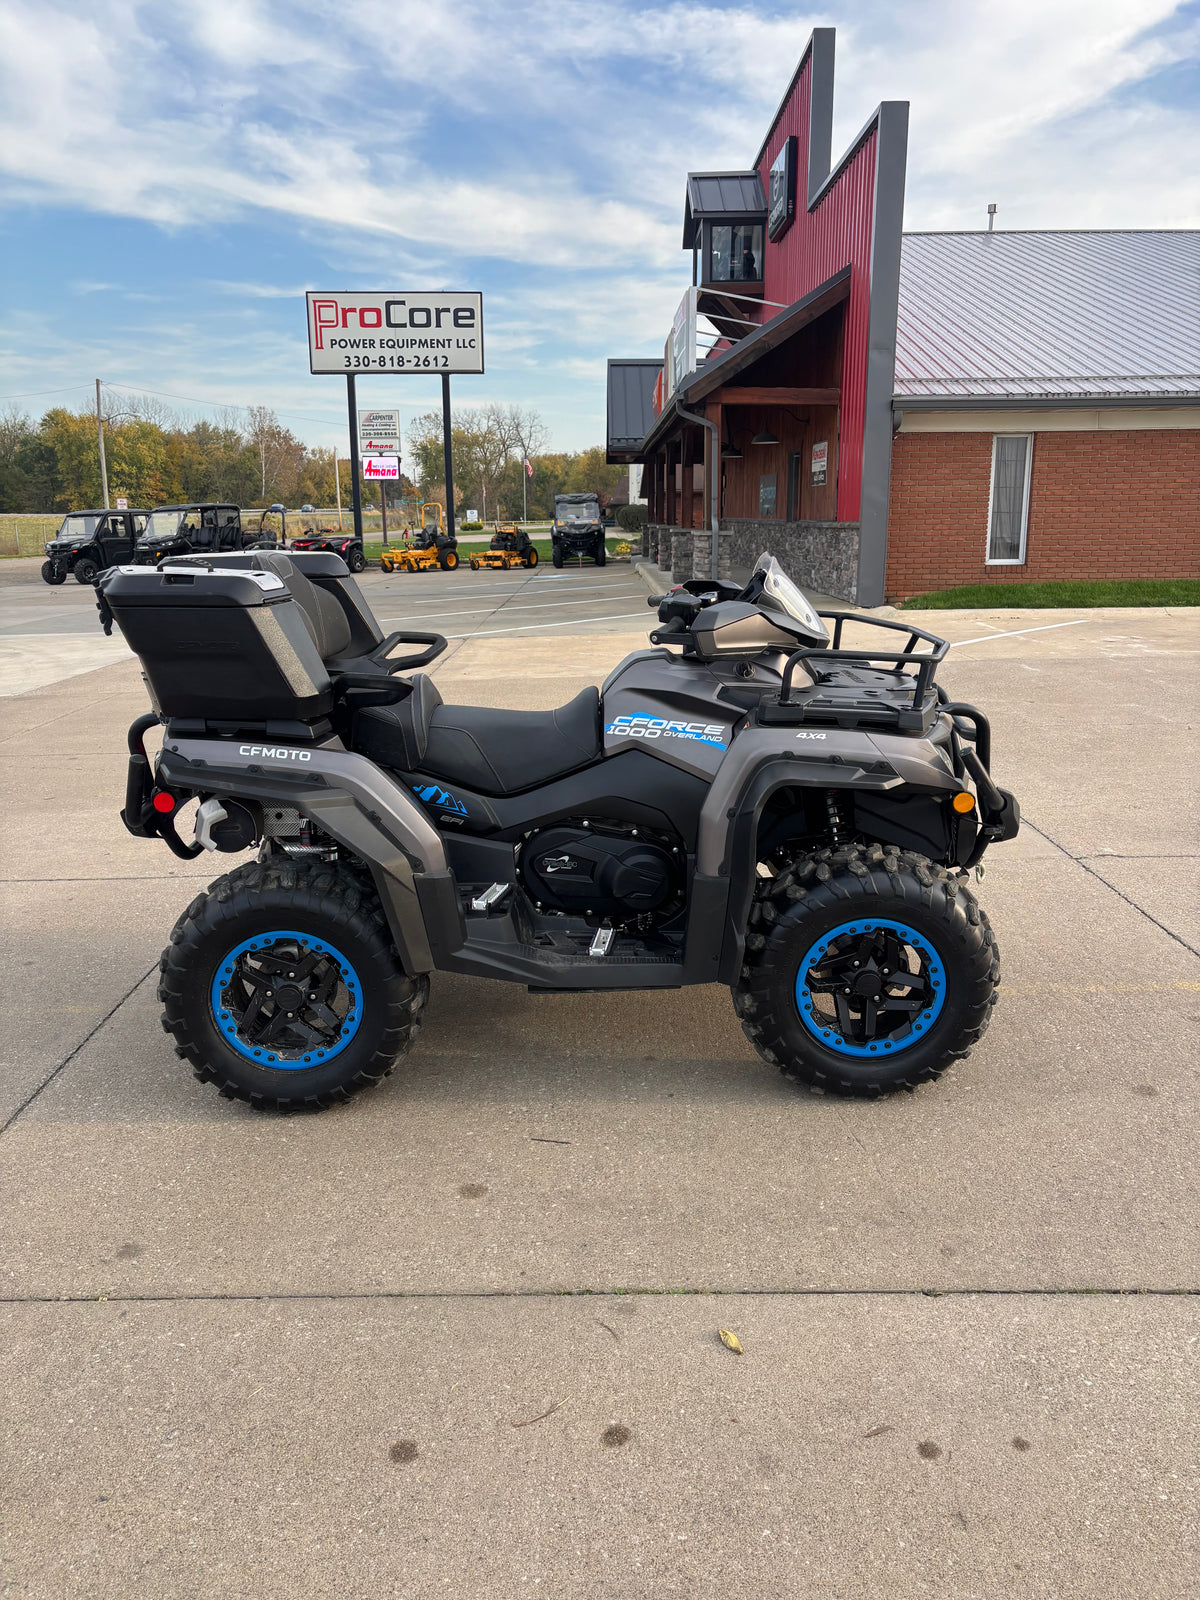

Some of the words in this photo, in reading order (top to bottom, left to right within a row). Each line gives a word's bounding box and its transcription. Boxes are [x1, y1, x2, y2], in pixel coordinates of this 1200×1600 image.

[312, 299, 475, 349] ProCore
[330, 338, 376, 349] POWER
[380, 338, 453, 349] EQUIPMENT
[456, 338, 476, 349] LLC
[344, 355, 449, 367] 330-818-2612
[366, 440, 394, 449] Amana
[365, 460, 397, 477] Amana
[607, 725, 660, 739] 1000
[663, 731, 722, 743] OVERLAND
[613, 715, 725, 736] CFORCE
[239, 745, 311, 762] CFMOTO
